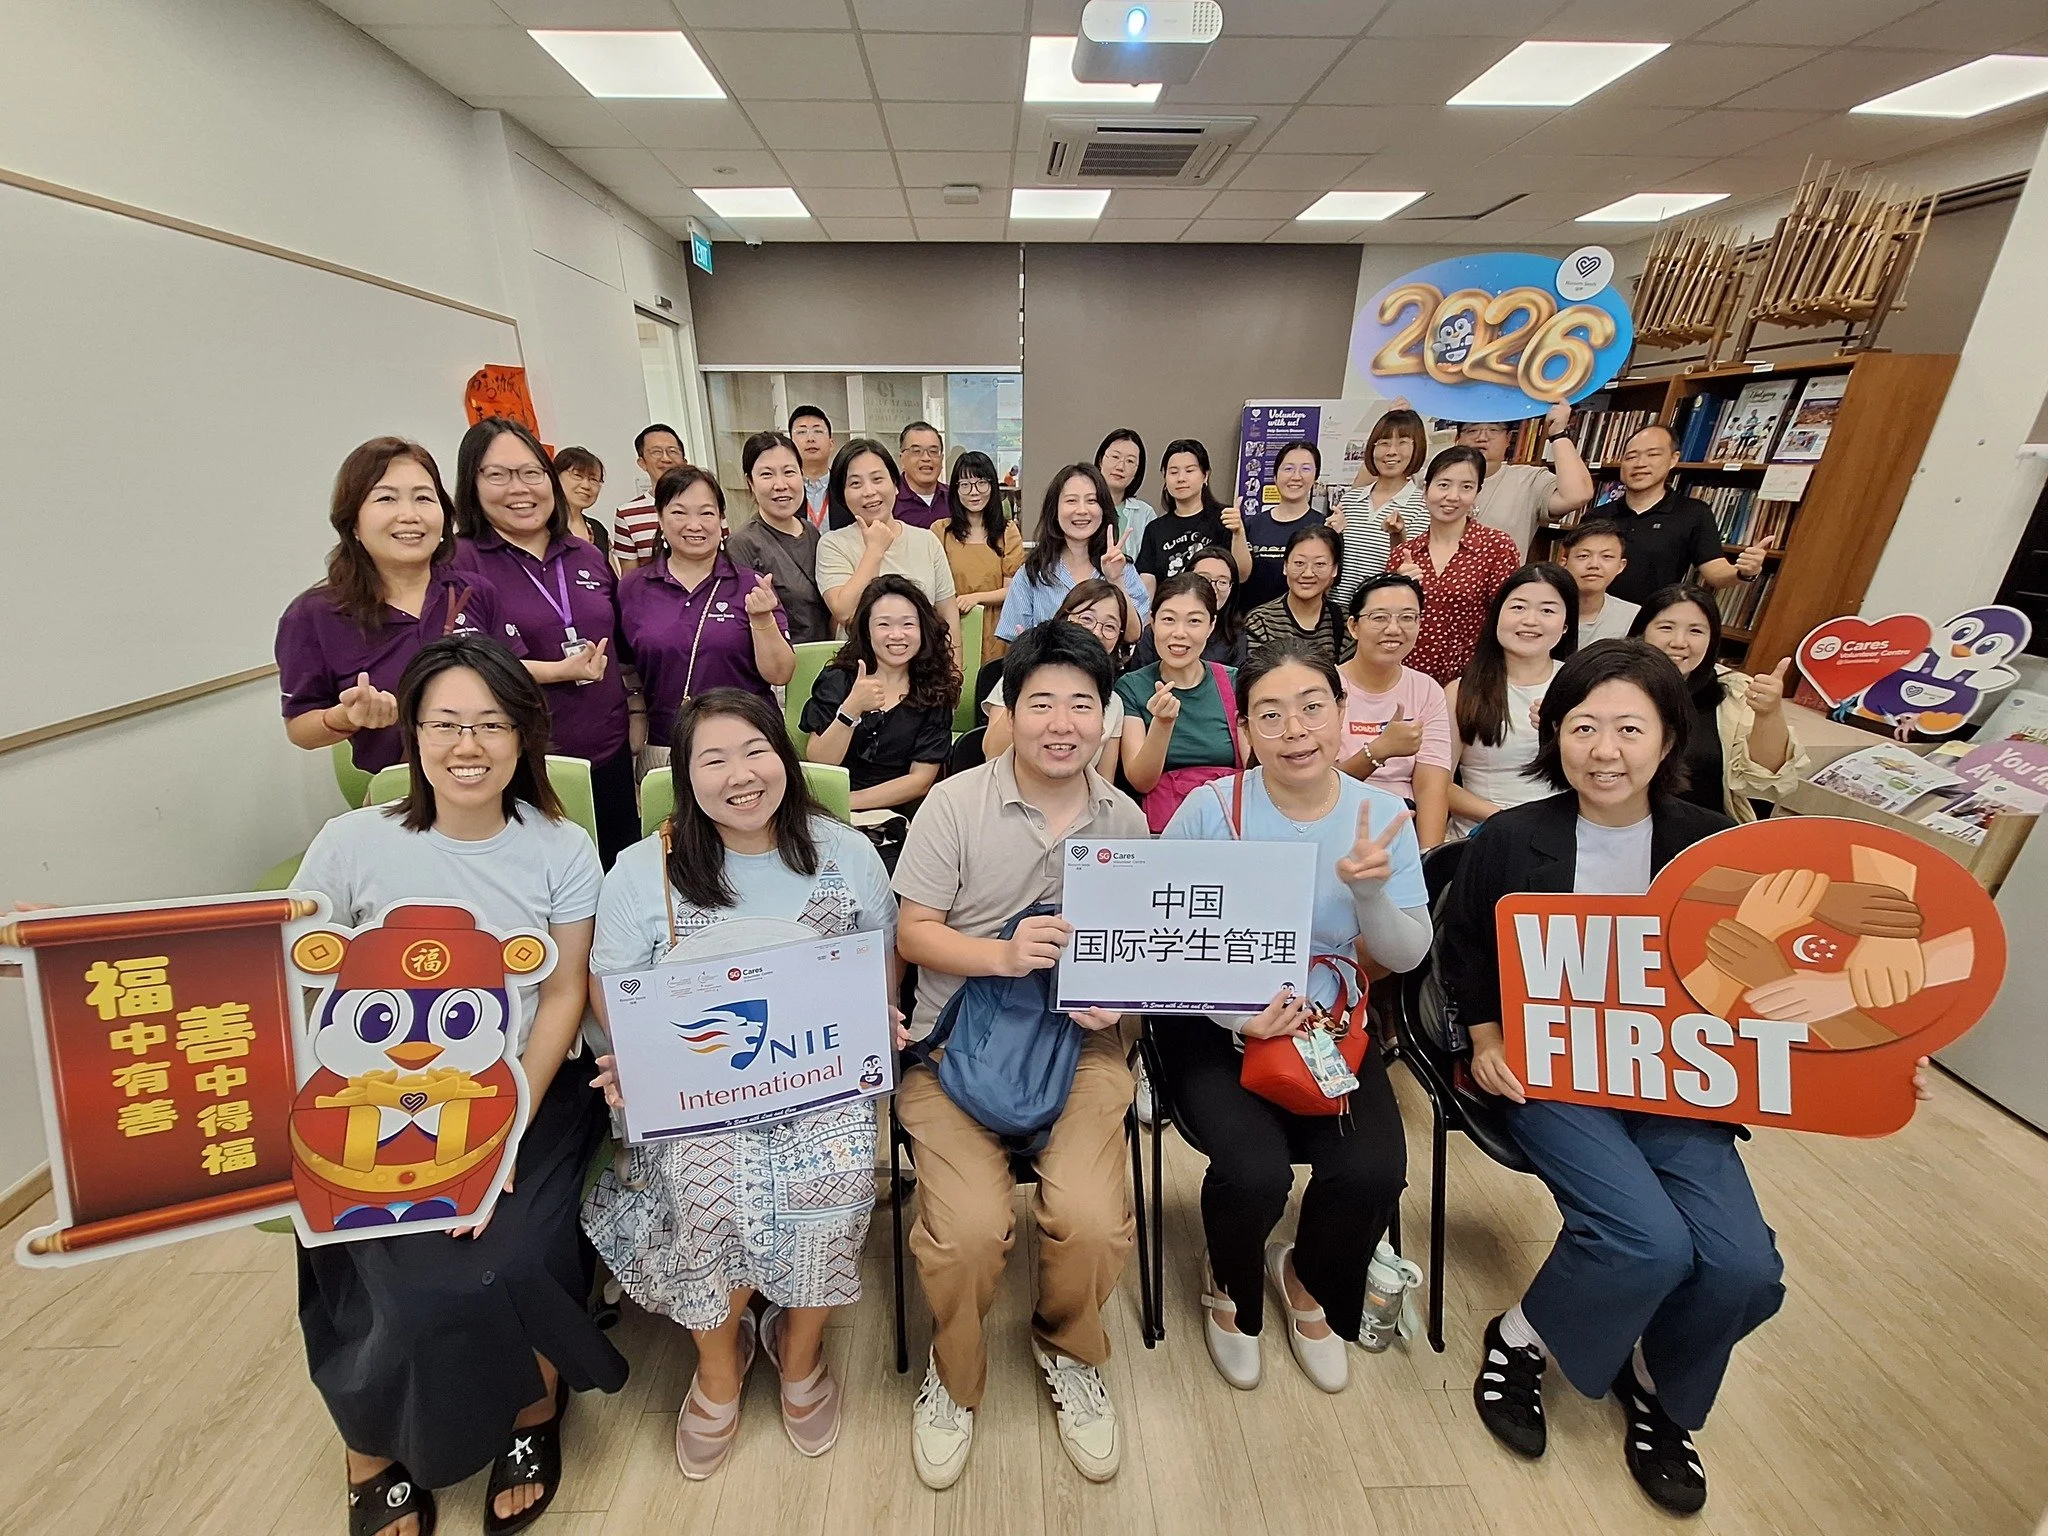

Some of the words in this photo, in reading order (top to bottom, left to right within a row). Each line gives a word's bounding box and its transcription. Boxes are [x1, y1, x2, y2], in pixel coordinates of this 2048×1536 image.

[1370, 282, 1616, 403] 2026
[1267, 418, 1286, 427] with
[1268, 409, 1307, 419] Volunteer
[1815, 642, 1836, 654] SG
[1842, 640, 1890, 652] Cares
[1880, 649, 1911, 657] Centre
[1098, 852, 1110, 860] SG
[1113, 852, 1135, 860] Cares
[1152, 882, 1225, 920] 中国
[410, 945, 445, 975] 福
[1073, 926, 1297, 965] 国际学生管理
[1512, 913, 1666, 1008] WE
[728, 970, 741, 979] SG
[742, 966, 763, 976] Cares
[84, 955, 180, 1138] 福中有善
[769, 1023, 840, 1064] NIE
[1522, 1002, 1809, 1116] FIRST
[175, 1002, 259, 1176] 善中得福
[678, 1055, 844, 1111] International
